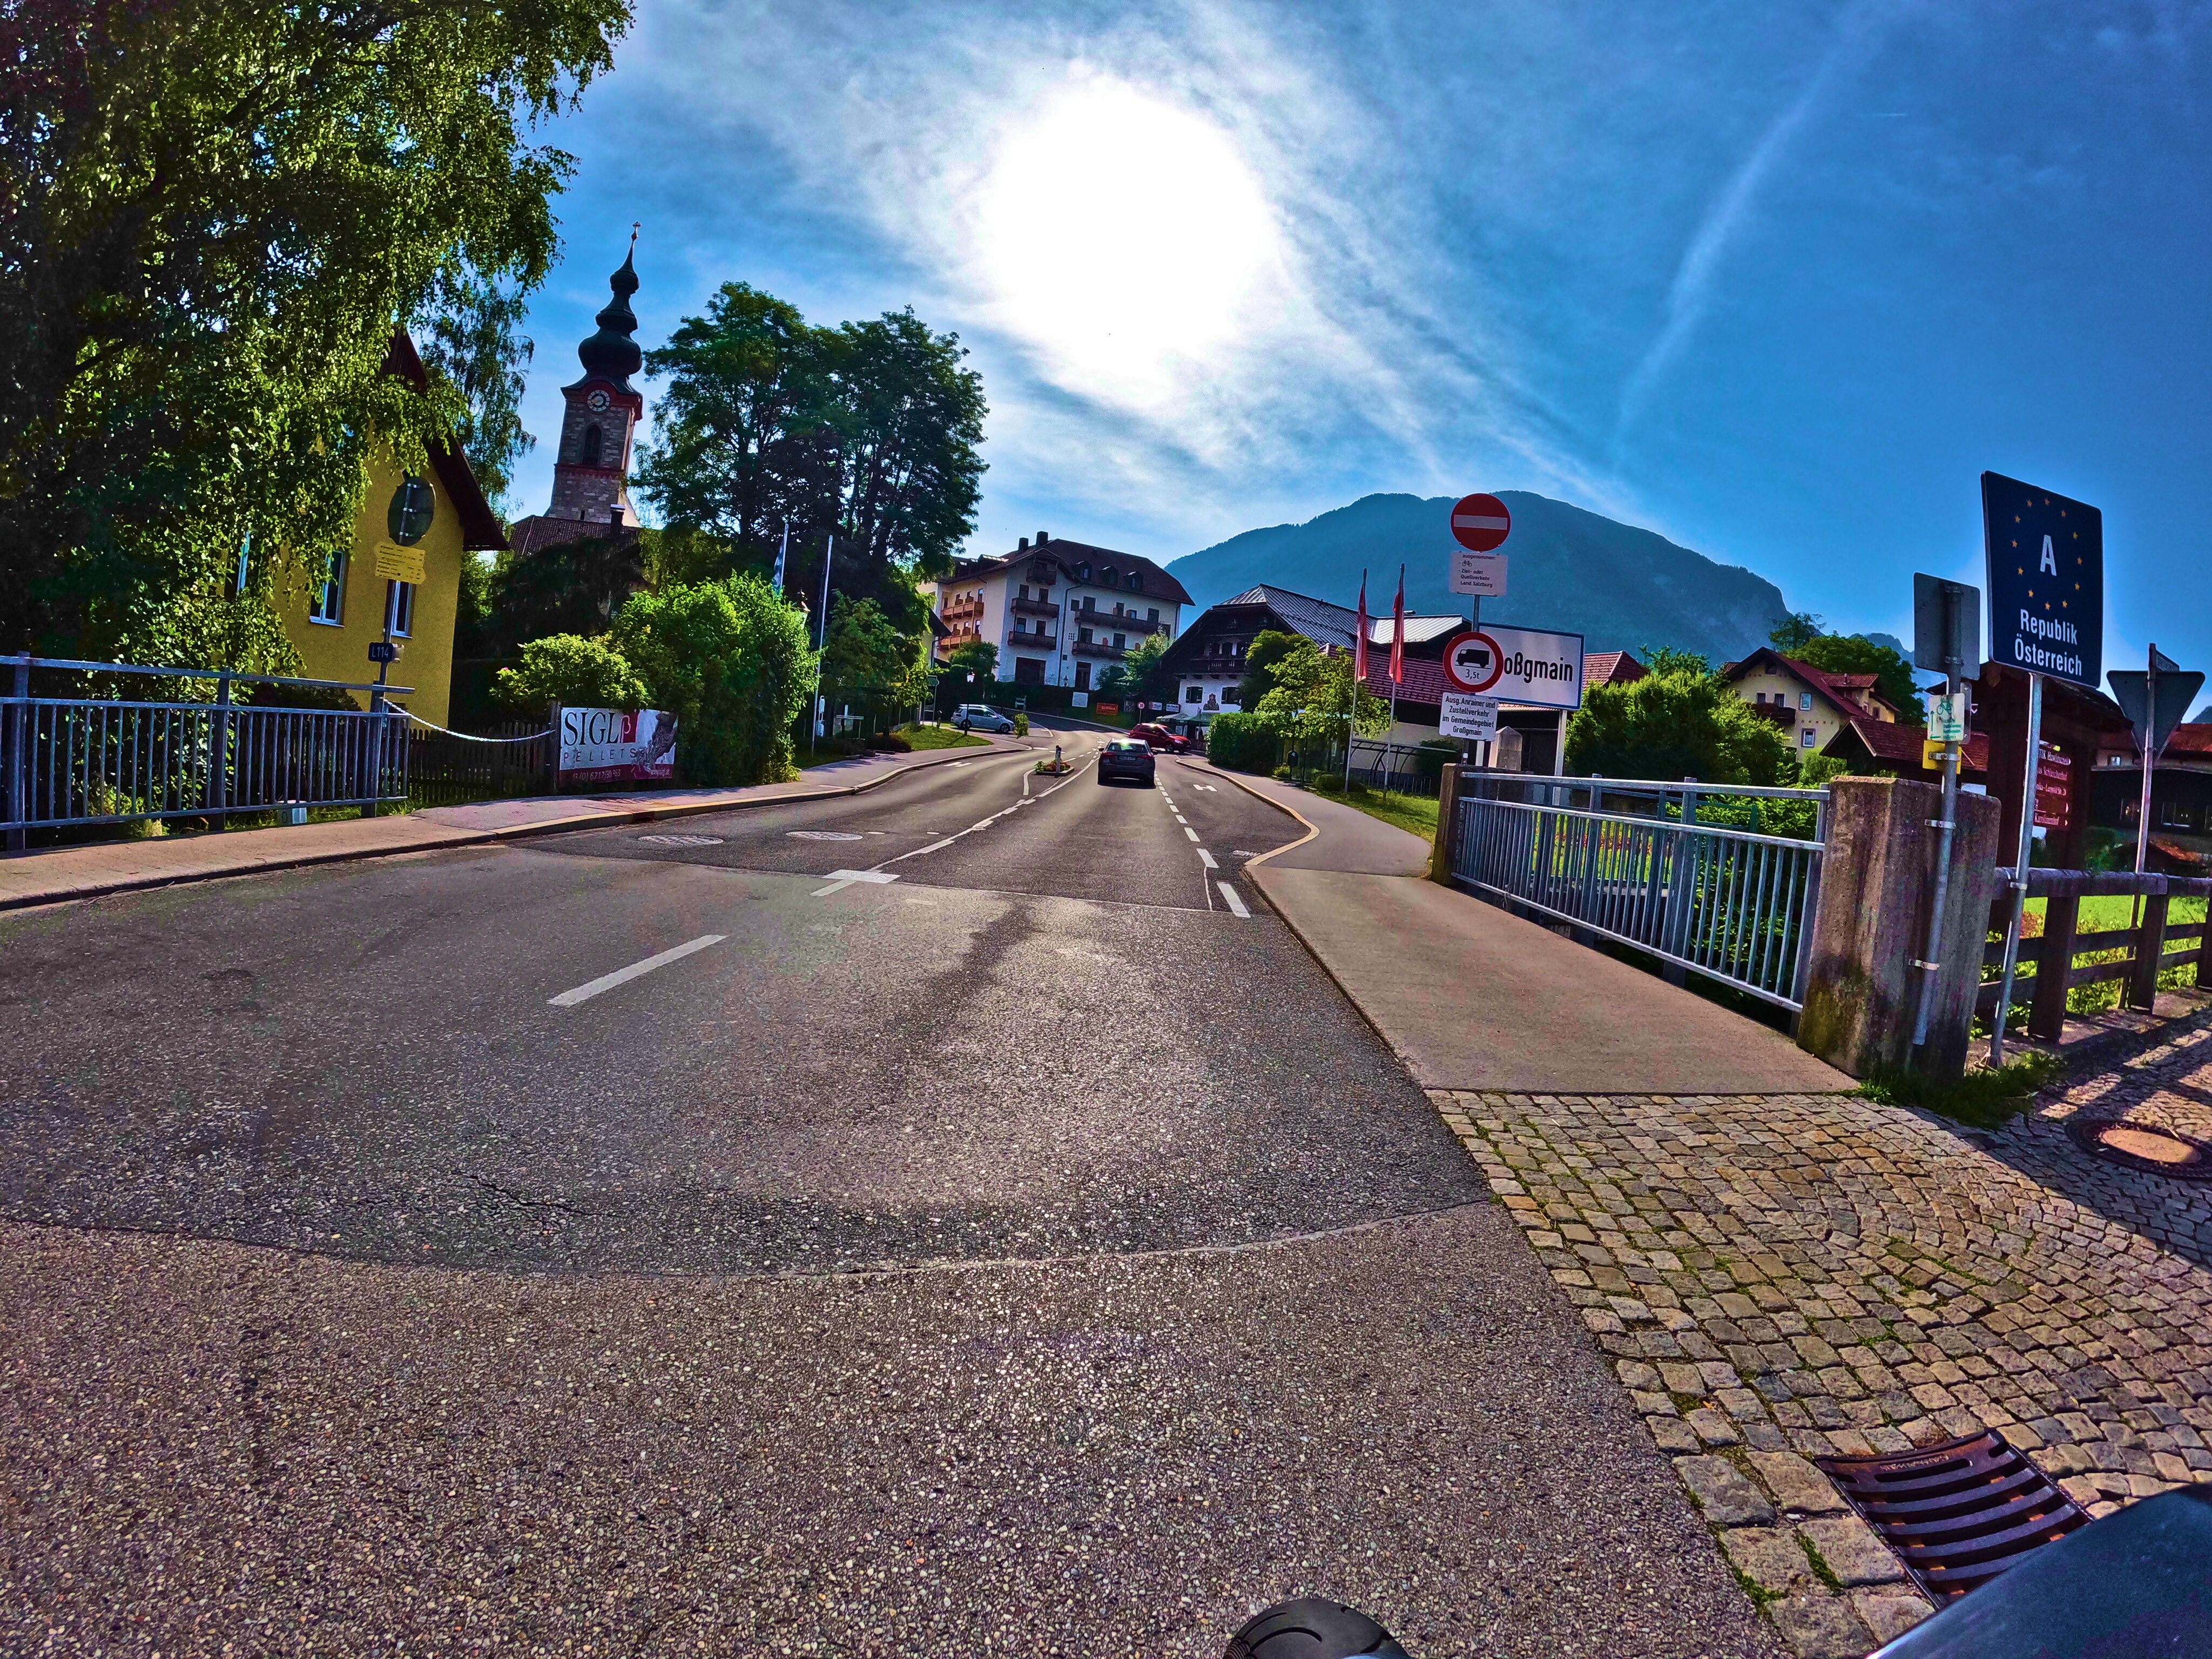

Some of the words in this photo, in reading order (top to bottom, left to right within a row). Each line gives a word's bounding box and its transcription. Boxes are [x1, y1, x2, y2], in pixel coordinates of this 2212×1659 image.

[2040, 534, 2057, 576] A
[2020, 609, 2078, 645] Republik
[372, 646, 389, 658] L114
[2015, 633, 2082, 676] Österreich
[1465, 669, 1480, 680] 3,5t
[1503, 652, 1573, 684] oßgmain
[1445, 695, 1461, 705] Ausg.
[1461, 697, 1485, 707] Anrainer
[1449, 705, 1489, 717] Zustellverkehr
[1442, 714, 1449, 722] im
[1451, 716, 1494, 728] Gemeindegebiet
[564, 712, 619, 746] SIGL
[1453, 725, 1482, 736] Großgmain
[564, 747, 637, 763] PELLETS
